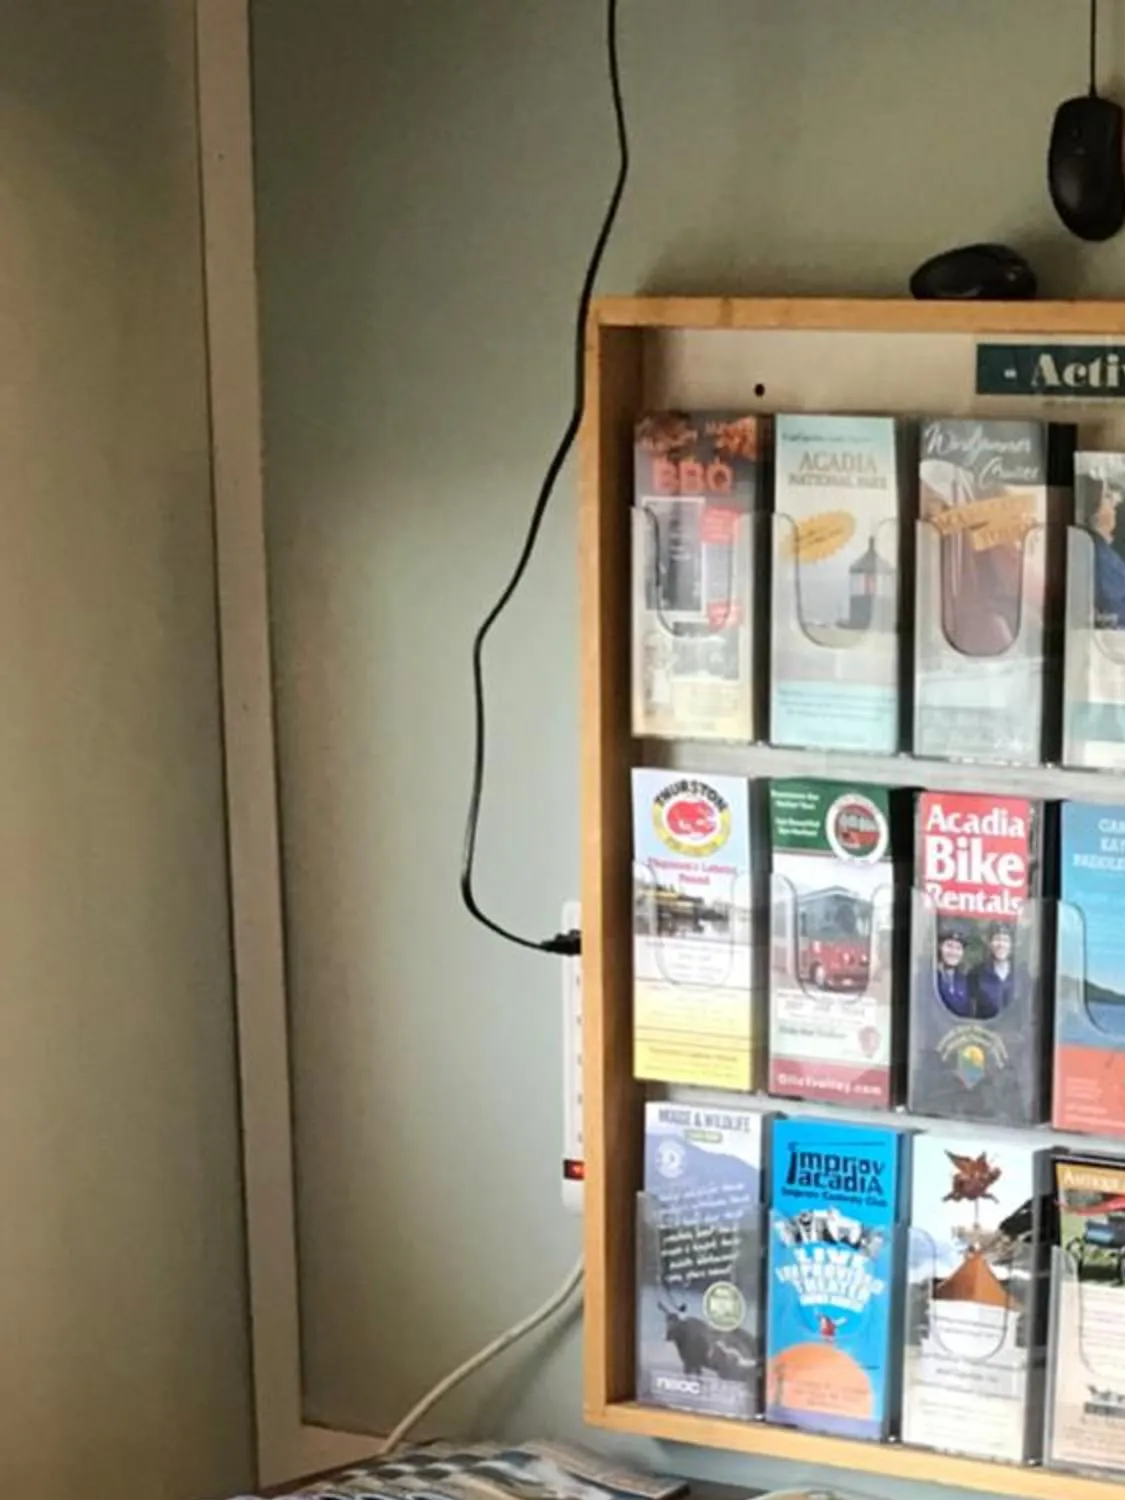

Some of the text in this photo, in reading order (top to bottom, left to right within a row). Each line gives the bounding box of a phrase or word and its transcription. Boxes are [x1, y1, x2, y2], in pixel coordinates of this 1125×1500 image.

[650, 456, 734, 494] BBQ
[797, 450, 879, 474] ACADIA
[925, 803, 1025, 838] Acadia
[923, 834, 1026, 888] Bike
[922, 882, 1024, 917] Rentals
